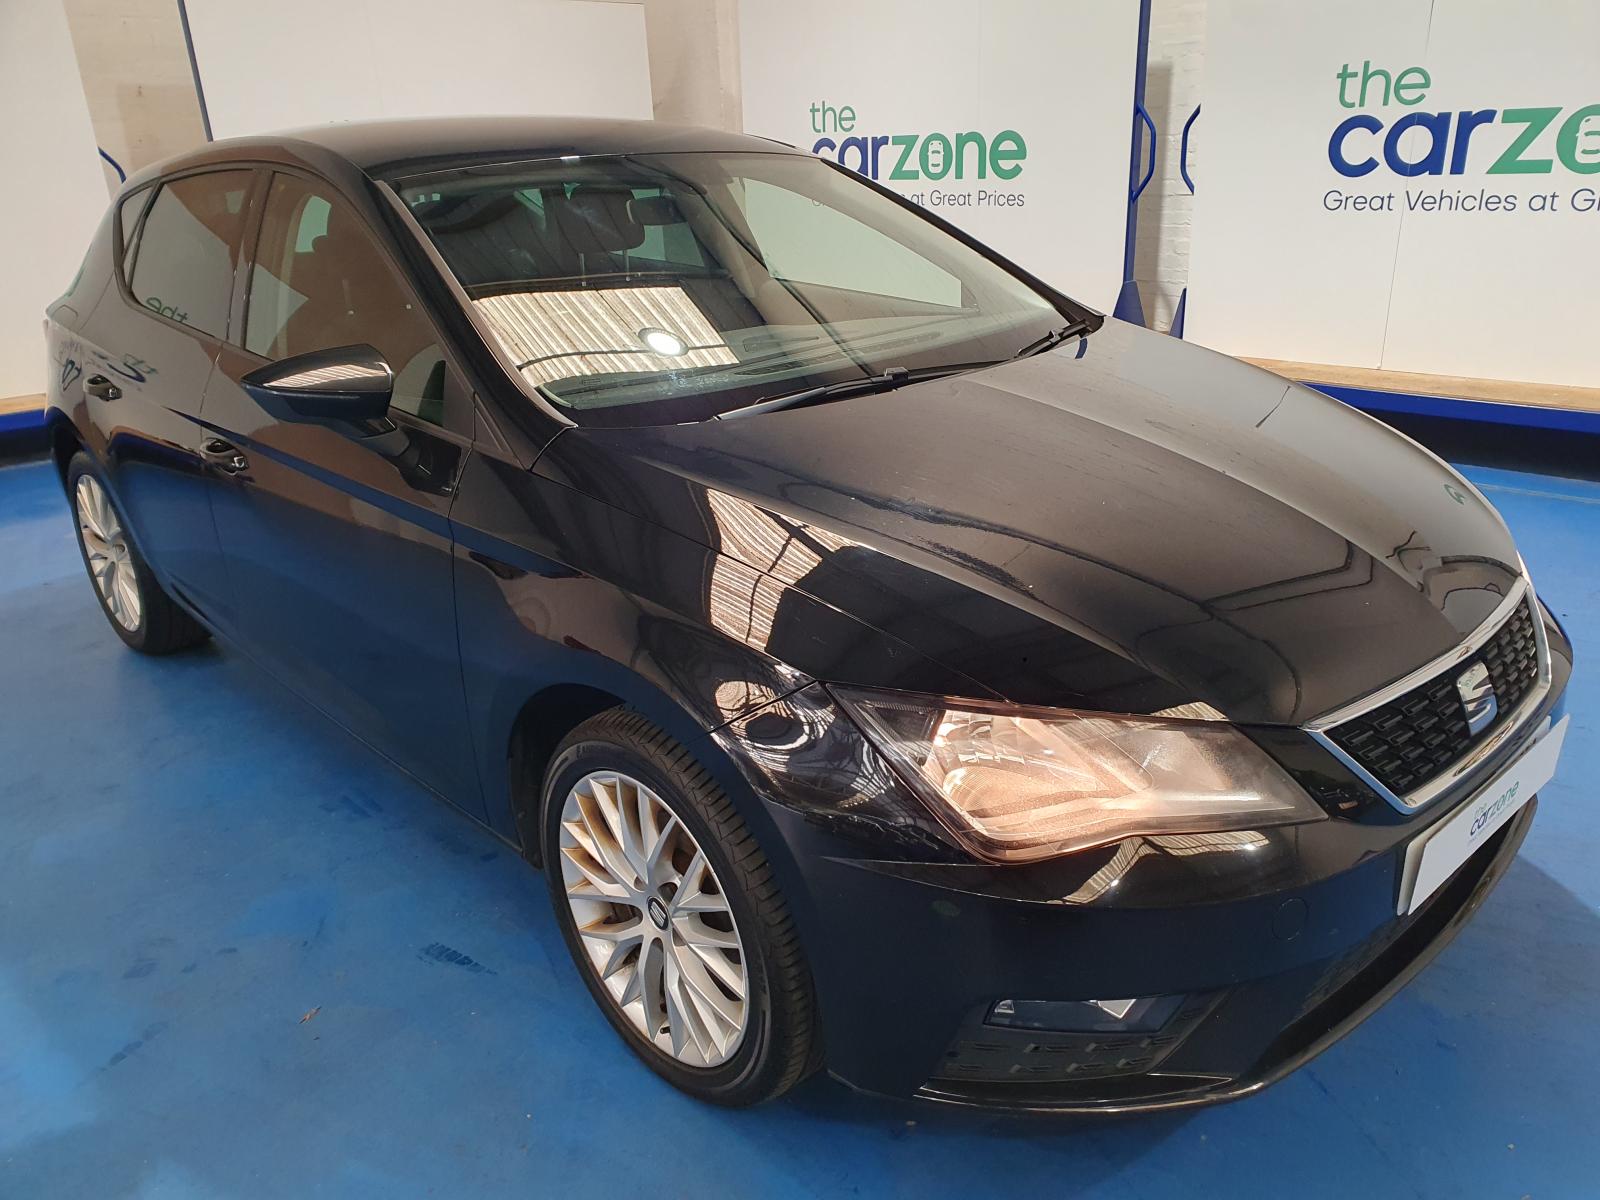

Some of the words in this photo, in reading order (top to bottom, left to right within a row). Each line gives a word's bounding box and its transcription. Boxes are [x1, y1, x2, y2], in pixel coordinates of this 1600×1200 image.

[1336, 60, 1431, 108] the
[809, 100, 856, 133] the
[930, 190, 972, 206] Great
[977, 190, 1025, 207] Prices
[1323, 190, 1394, 211] Great
[1405, 189, 1517, 211] Vehicles
[1528, 191, 1559, 211] at
[1470, 781, 1520, 836] carzone
